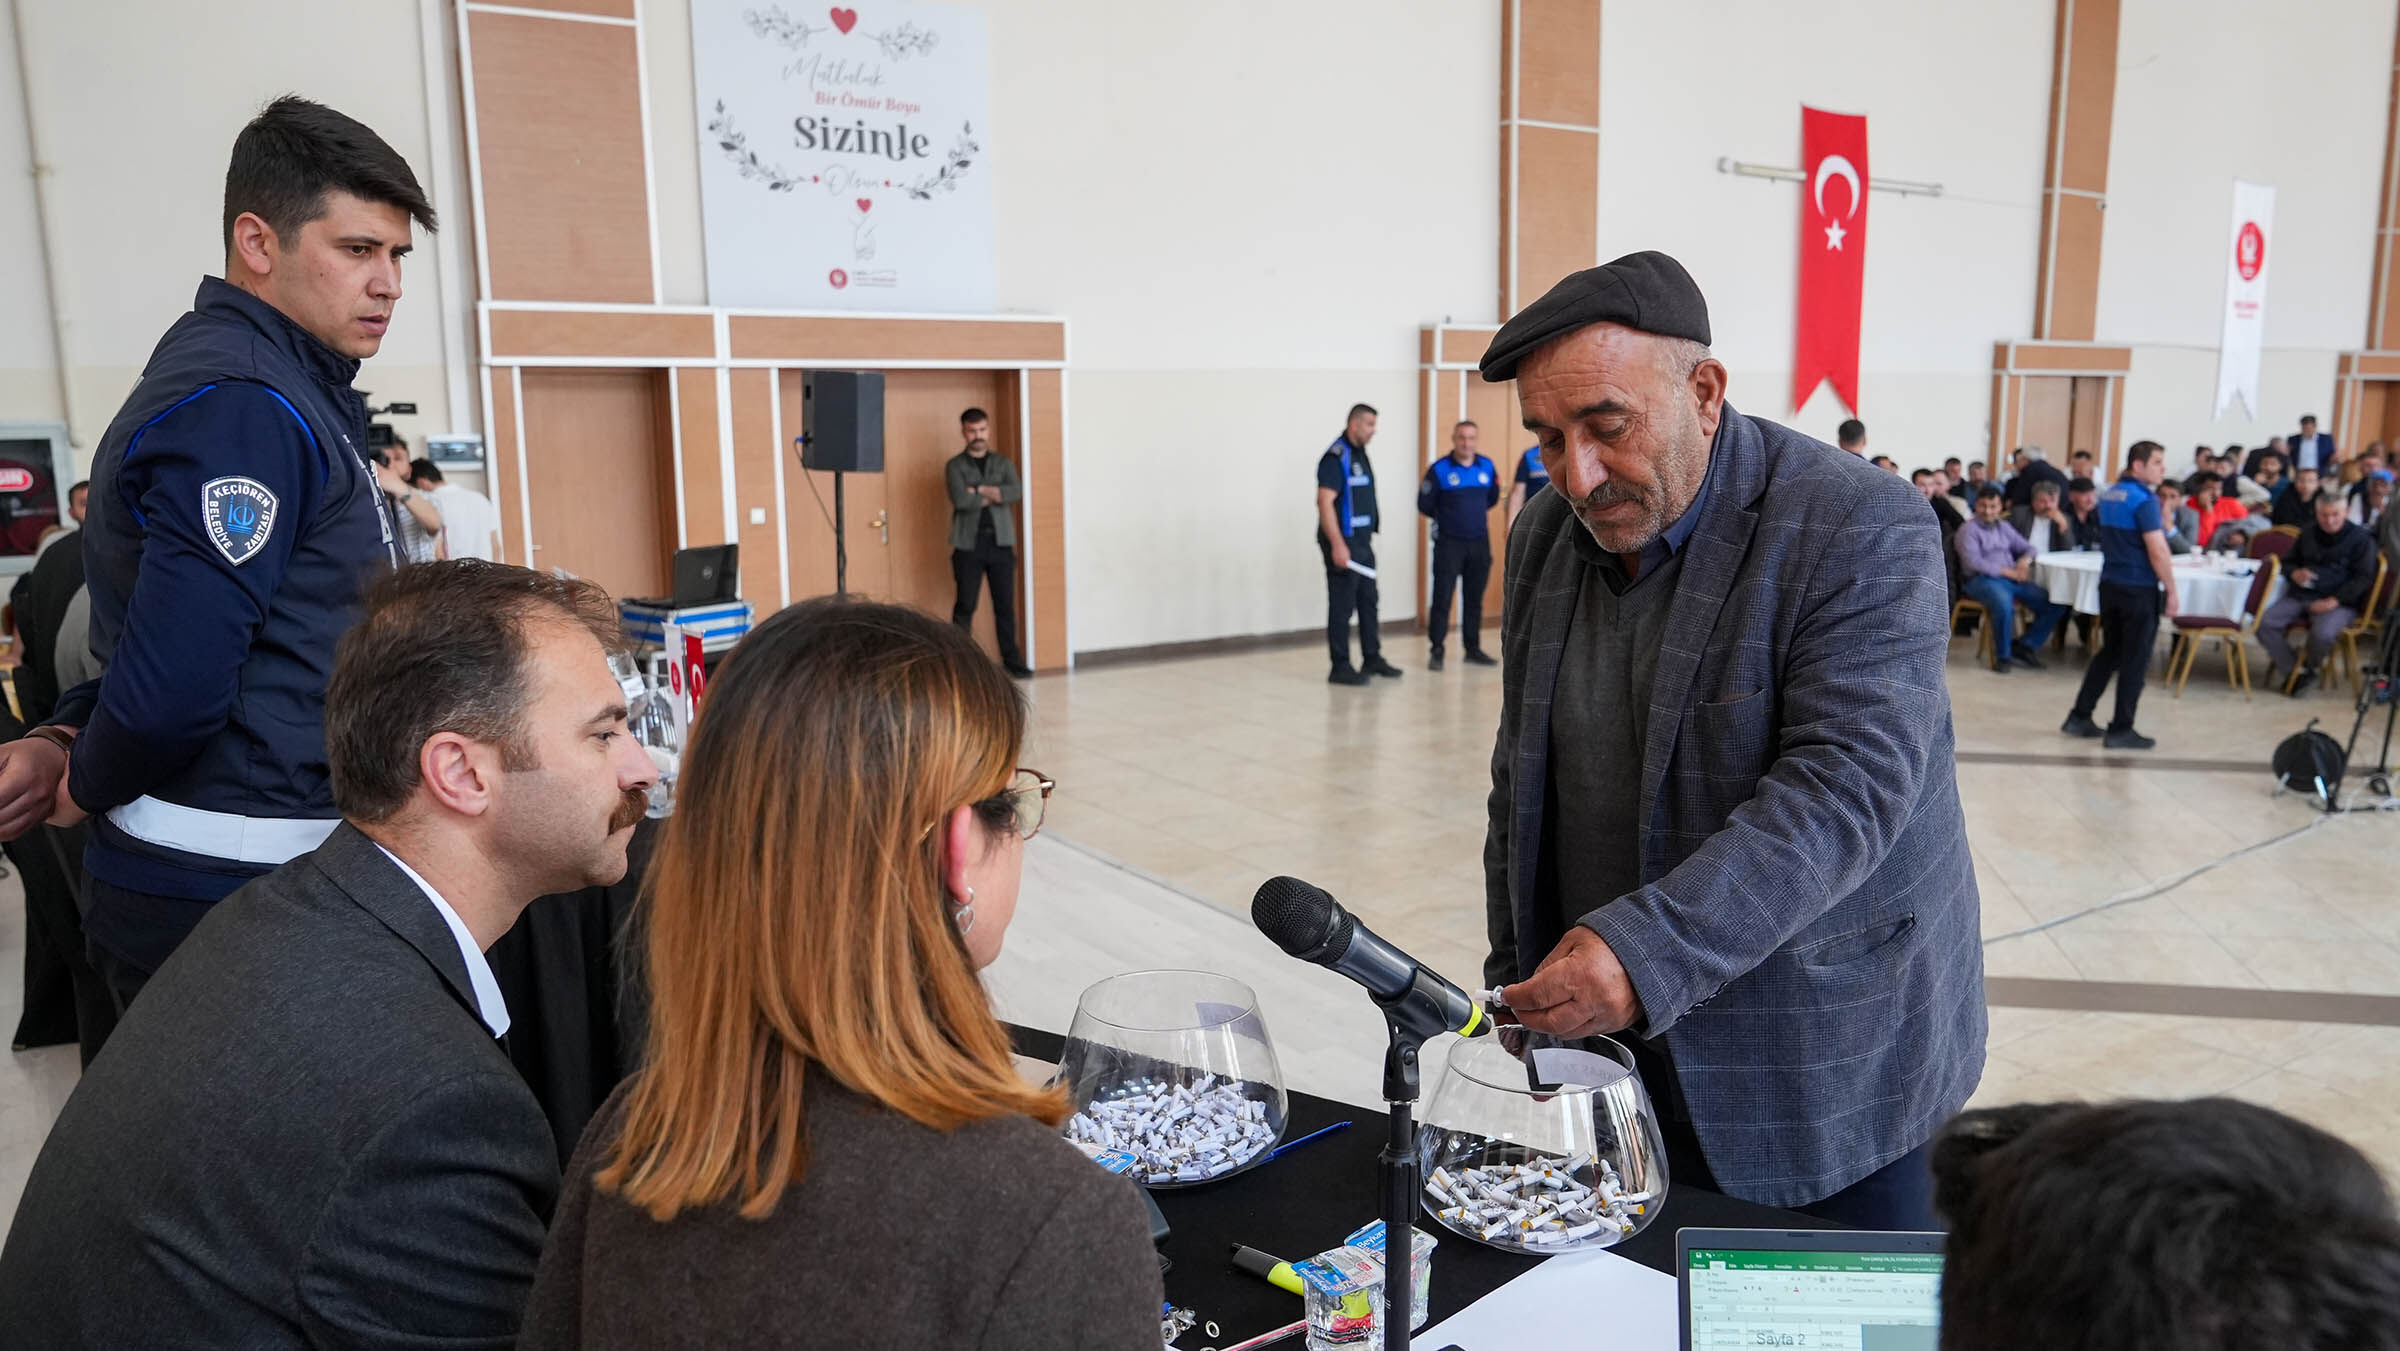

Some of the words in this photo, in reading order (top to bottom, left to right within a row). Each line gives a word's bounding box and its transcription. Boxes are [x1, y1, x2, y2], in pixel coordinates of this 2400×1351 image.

[815, 91, 837, 105] Bir
[886, 97, 921, 117] Boyu
[794, 115, 930, 162] Sizinle
[213, 482, 271, 507] KEÇİÖREN
[209, 500, 234, 550] BELEDİYE
[1756, 1332, 1794, 1347] Sayfa
[1798, 1333, 1806, 1346] 2
